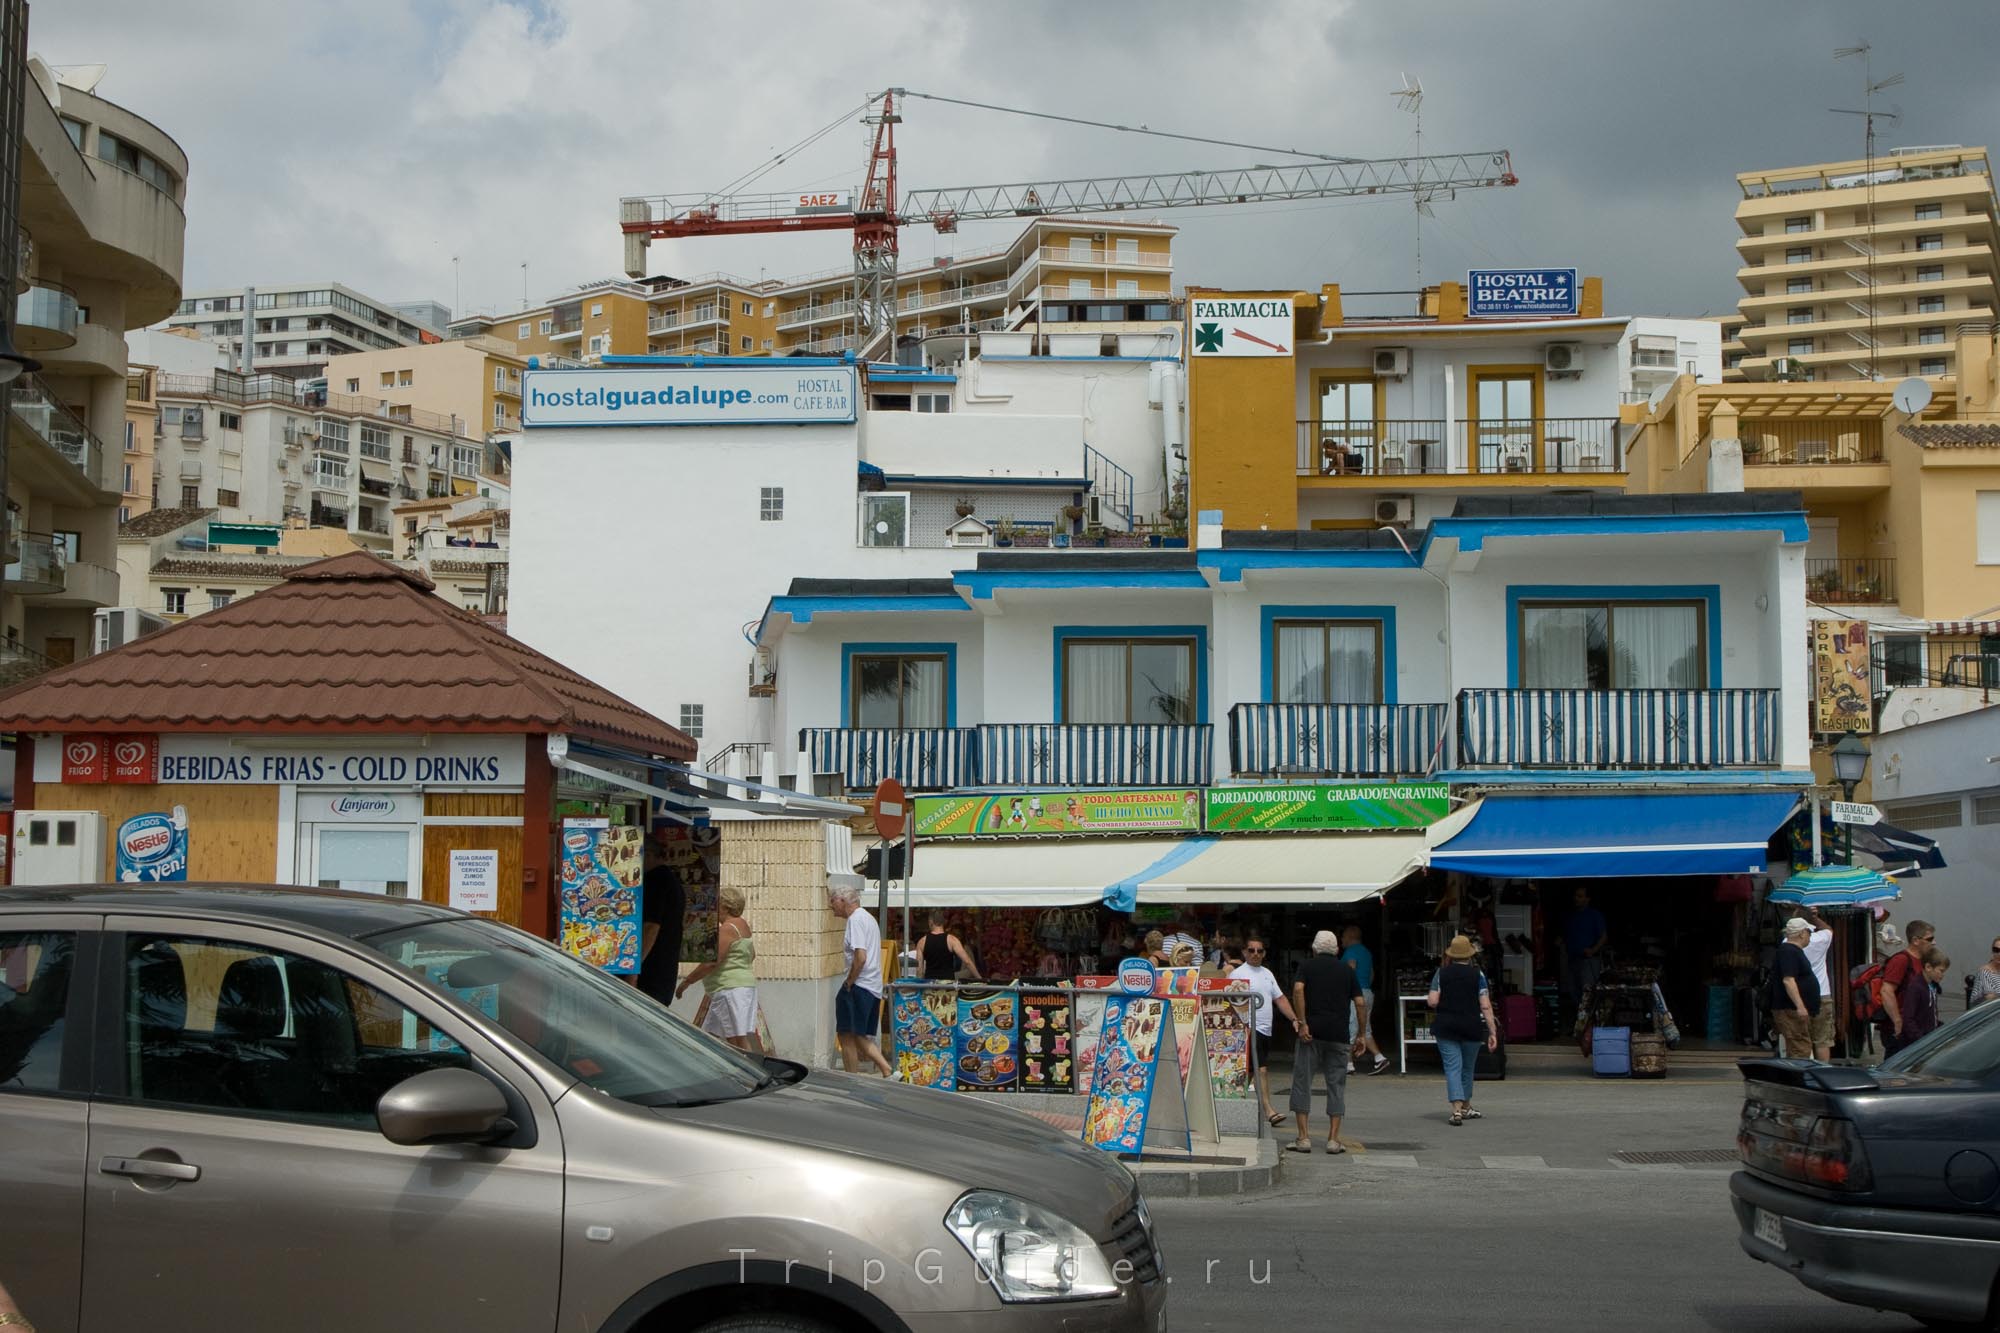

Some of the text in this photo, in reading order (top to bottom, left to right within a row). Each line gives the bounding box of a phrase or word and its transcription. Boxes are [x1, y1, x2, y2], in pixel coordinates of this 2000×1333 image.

[799, 194, 838, 206] SAEZ
[1476, 274, 1548, 288] HOSTAL
[1476, 288, 1569, 301] BEATRIZ
[1194, 301, 1290, 319] FARMACIA
[797, 379, 844, 393] HOSTAL
[532, 385, 789, 411] hostalguadalupe.com
[1822, 717, 1870, 730] FASHION
[68, 766, 92, 776] FRIGO
[116, 766, 141, 776] FRIGO
[162, 756, 252, 781] BEBIDAS
[262, 756, 324, 781] FRIAS
[342, 756, 407, 781] COLD
[415, 756, 500, 781] DRINKS
[1083, 792, 1179, 804] TODO ARTESANAL
[1211, 789, 1317, 804] BORDADO/BORDING
[1327, 786, 1448, 801] GRABADO/ENGRAVING
[338, 797, 389, 813] Lanjarón
[1095, 806, 1174, 818] HECHO A MANO
[1252, 800, 1289, 824] baberos
[1835, 803, 1874, 815] FARMACIA
[915, 799, 957, 832] REGALOS
[934, 800, 976, 832] ARCOIRIS
[1264, 800, 1307, 828] camisetas
[127, 818, 161, 833] HELADOS
[1127, 820, 1183, 828] PERSONALIZADOS
[127, 831, 169, 854] Nestlé
[1124, 962, 1148, 970] HELADOS
[1123, 974, 1152, 987] Nestlé
[1173, 1005, 1193, 1015] ARTE
